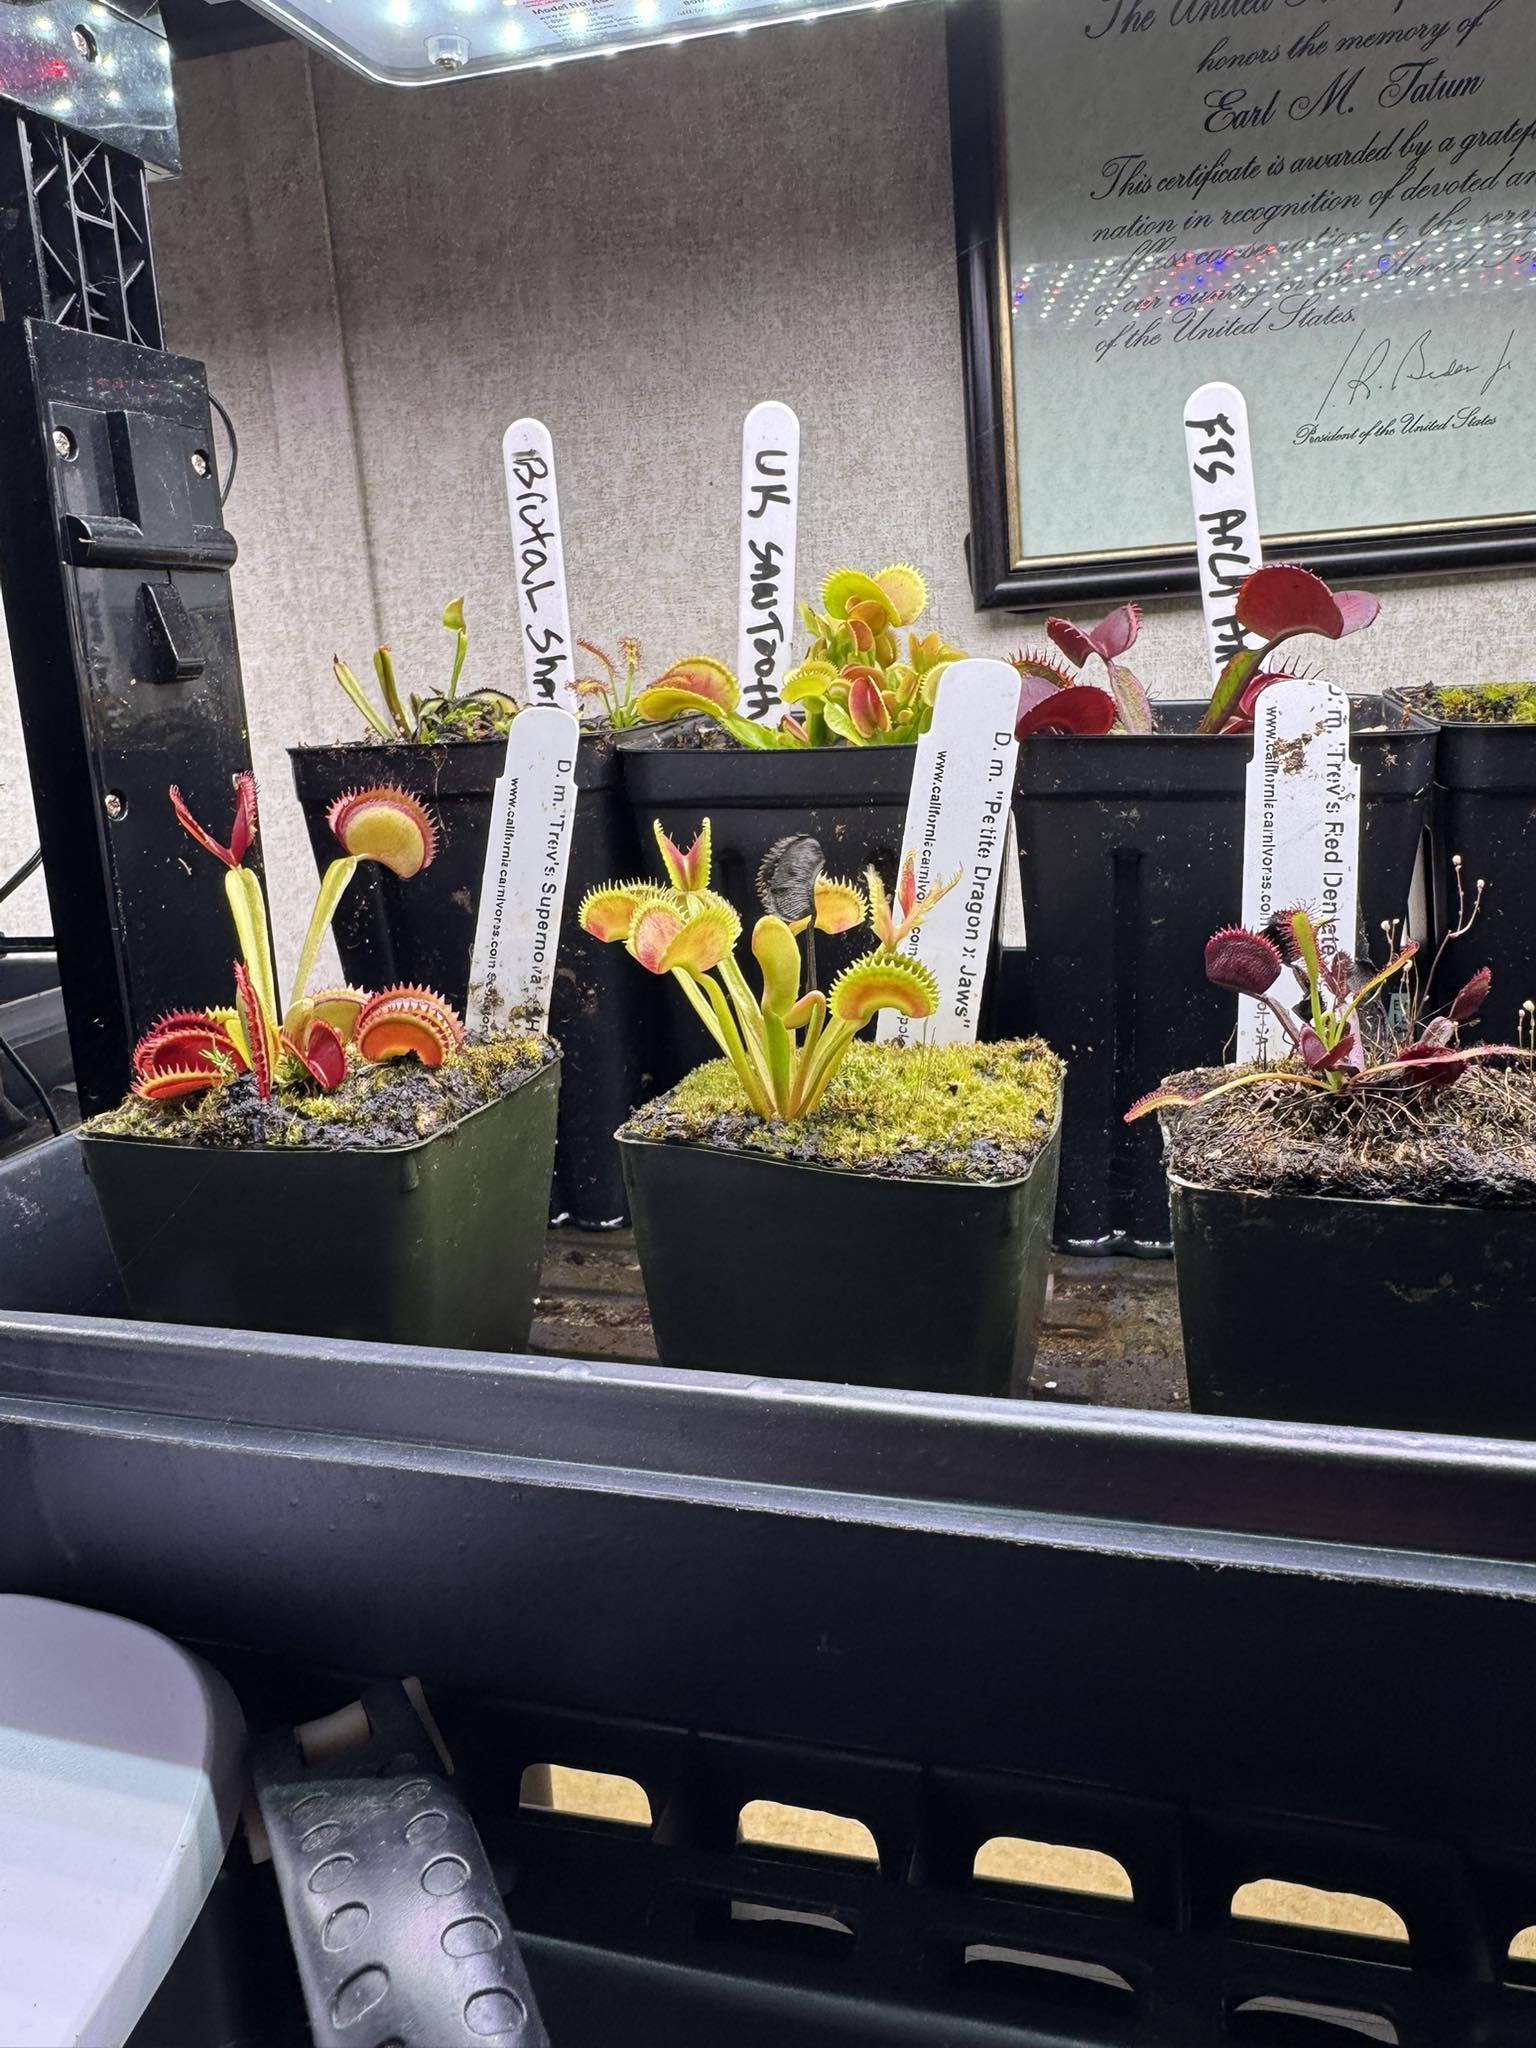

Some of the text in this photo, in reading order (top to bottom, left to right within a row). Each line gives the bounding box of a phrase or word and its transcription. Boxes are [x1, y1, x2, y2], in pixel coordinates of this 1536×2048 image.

[1196, 0, 1500, 73] honors the memory of
[1204, 57, 1486, 133] Earl M. Tatum
[1091, 153, 1153, 200] This
[1156, 148, 1260, 199] certificate
[1267, 158, 1287, 177] is
[1290, 128, 1405, 174] awarded
[1399, 120, 1433, 170] by
[1438, 136, 1456, 152] a
[1092, 215, 1178, 242] nation
[1184, 210, 1214, 230] in
[1221, 189, 1363, 234] recognition
[1369, 166, 1417, 218] of
[1401, 157, 1514, 201] devoted
[1094, 293, 1356, 362] of the United States.
[1292, 406, 1498, 445] President of the United States
[747, 450, 791, 518] UK
[556, 759, 572, 777] D.
[988, 759, 1004, 782] m.
[993, 731, 1012, 750] D.
[552, 785, 566, 806] m.
[1324, 822, 1345, 863] Red
[965, 865, 992, 940] Dragon
